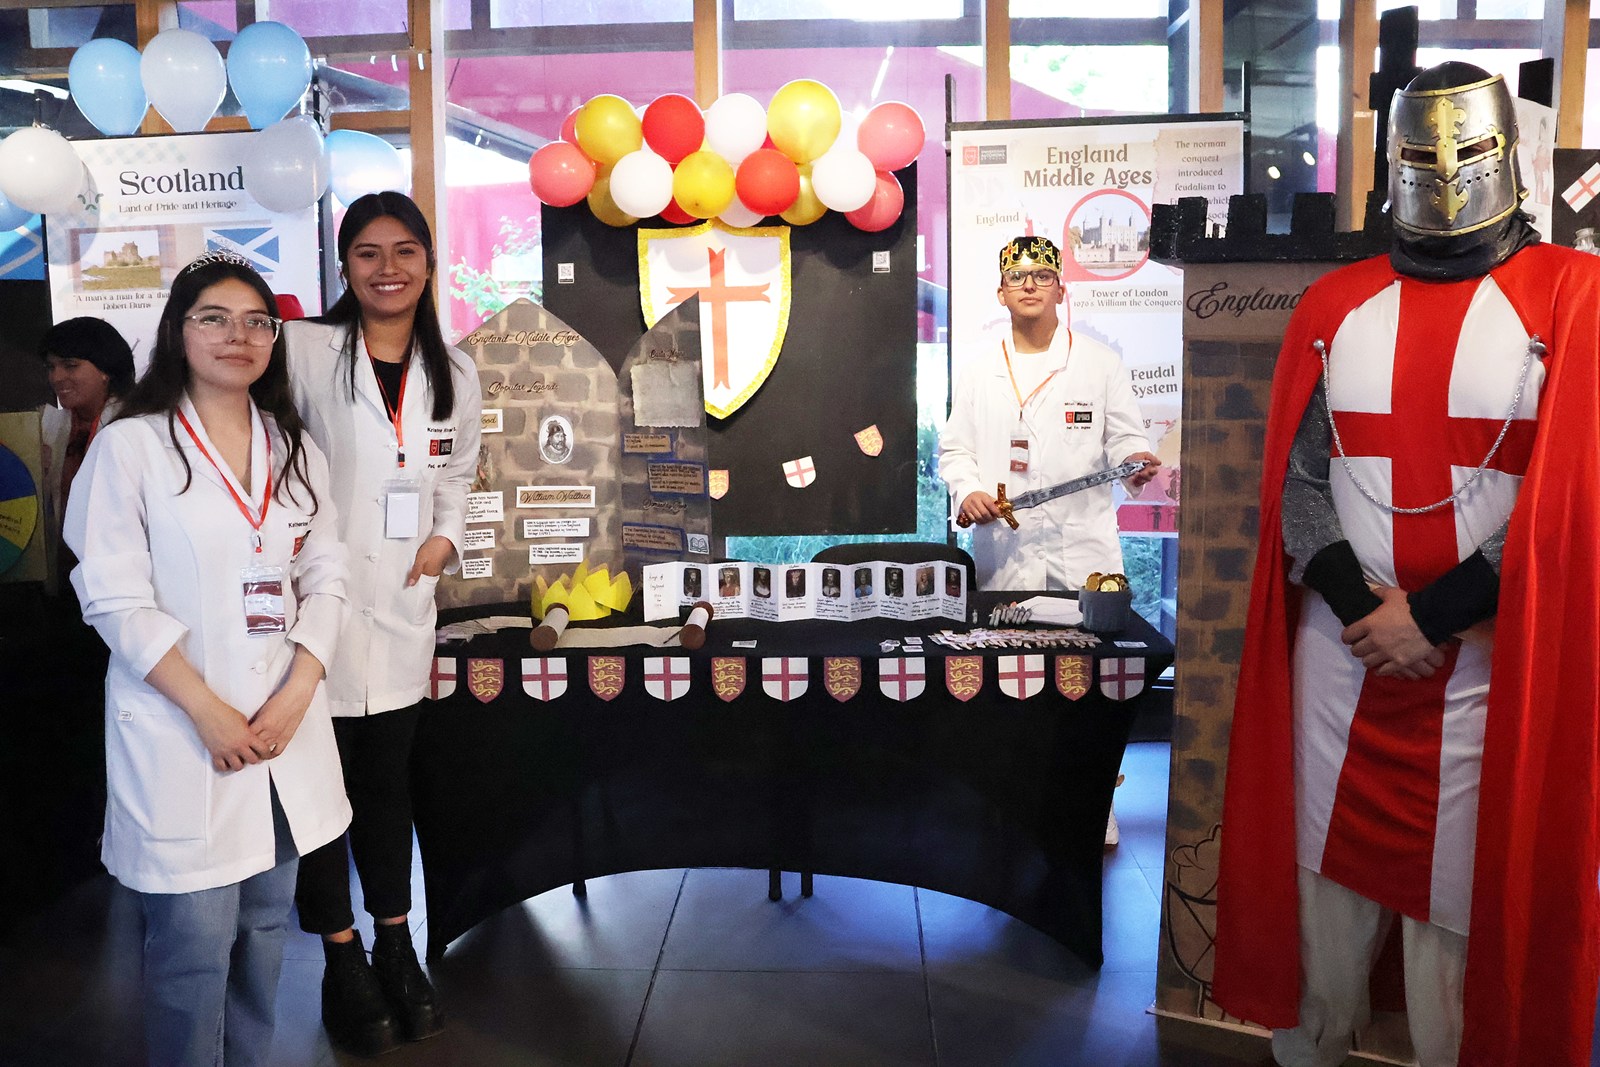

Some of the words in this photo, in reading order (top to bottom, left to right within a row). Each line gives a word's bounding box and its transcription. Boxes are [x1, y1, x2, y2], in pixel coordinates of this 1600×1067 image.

[1175, 141, 1190, 149] The
[1193, 140, 1226, 148] norman
[1047, 143, 1128, 168] England
[1182, 154, 1219, 163] conquest
[1024, 166, 1095, 188] Middle
[1103, 167, 1152, 189] Ages
[1178, 168, 1223, 177] introduced
[119, 166, 245, 196] Scotland
[1174, 183, 1215, 191] feudalism
[119, 204, 141, 212] Land
[144, 203, 153, 212] of
[182, 201, 198, 210] and
[976, 212, 1019, 226] England
[1091, 289, 1119, 298] Tower
[1122, 289, 1133, 297] of
[1135, 289, 1168, 297] London
[1098, 299, 1127, 307] William
[1130, 299, 1142, 307] the
[1144, 299, 1183, 308] Conquero
[1186, 282, 1310, 319] England
[1131, 364, 1175, 380] Feudal
[1131, 383, 1178, 399] System
